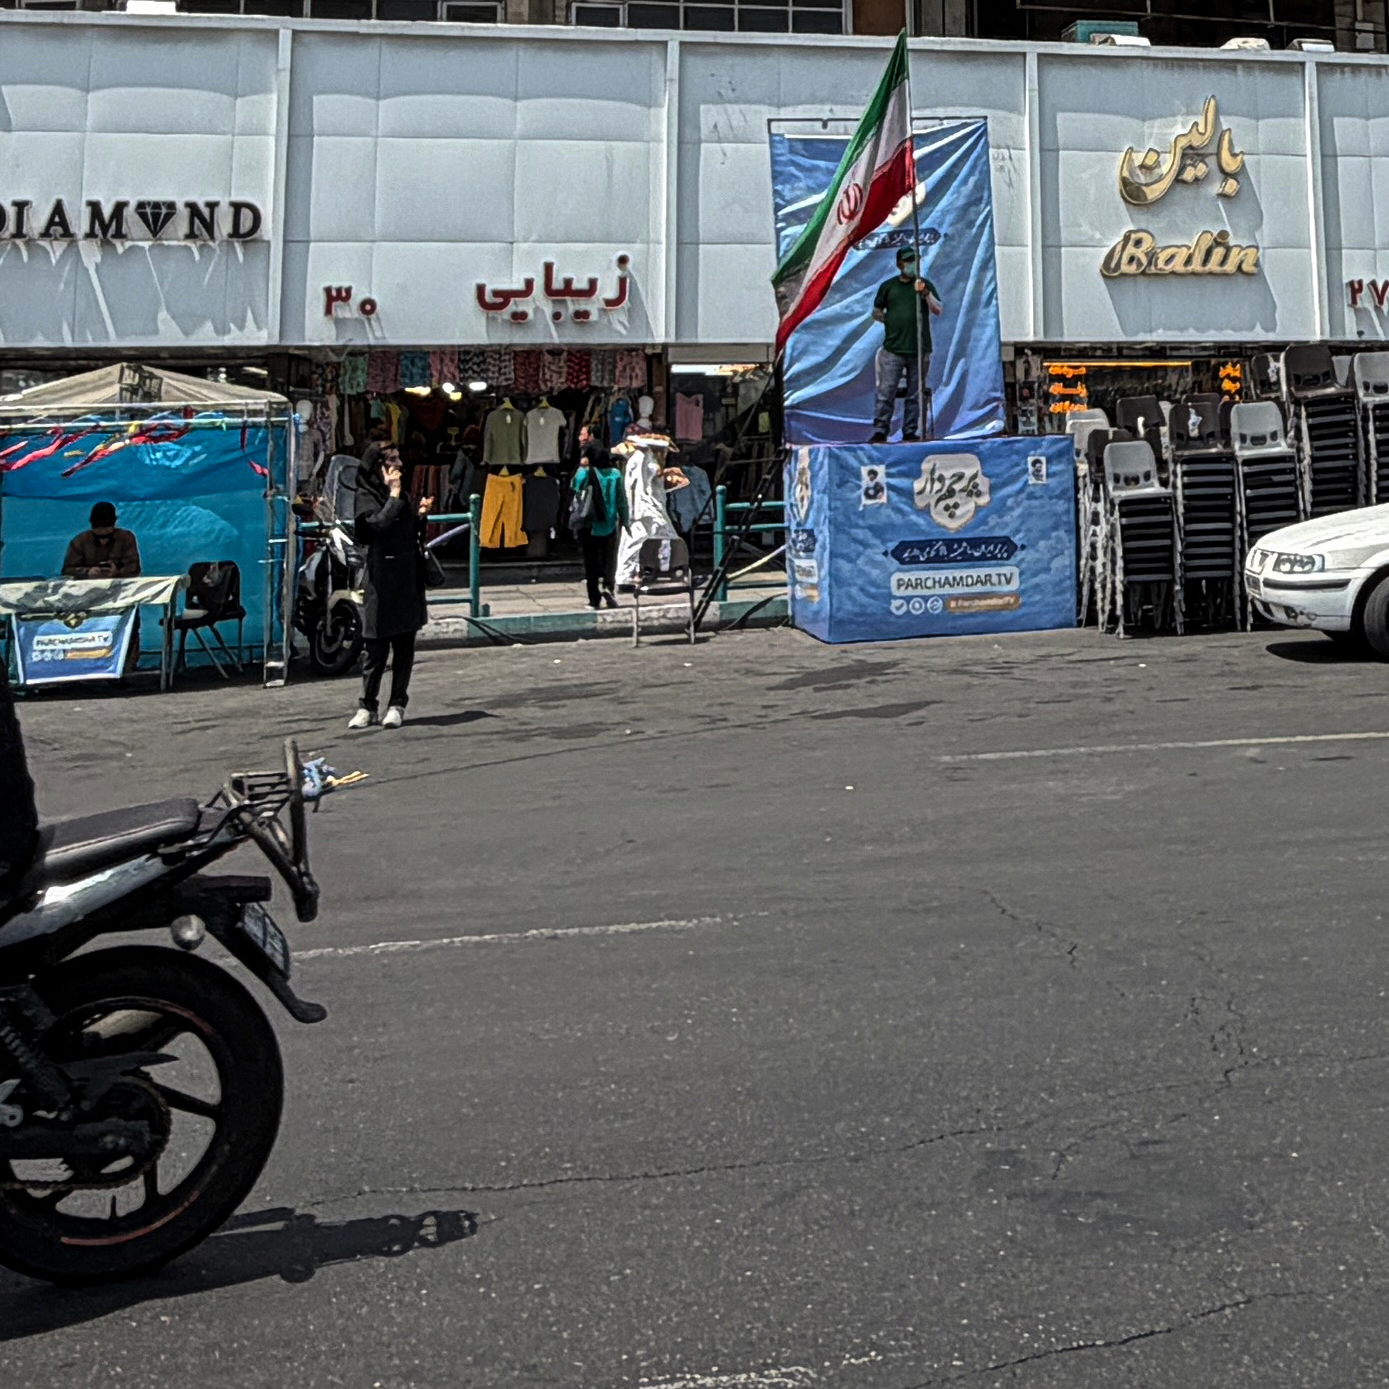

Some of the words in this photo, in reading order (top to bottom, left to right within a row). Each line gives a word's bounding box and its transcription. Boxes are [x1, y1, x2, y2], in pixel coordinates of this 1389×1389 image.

[1099, 228, 1261, 277] Balin
[476, 254, 630, 322] زیبایی
[895, 573, 1014, 592] PARCHAMDAR.TV
